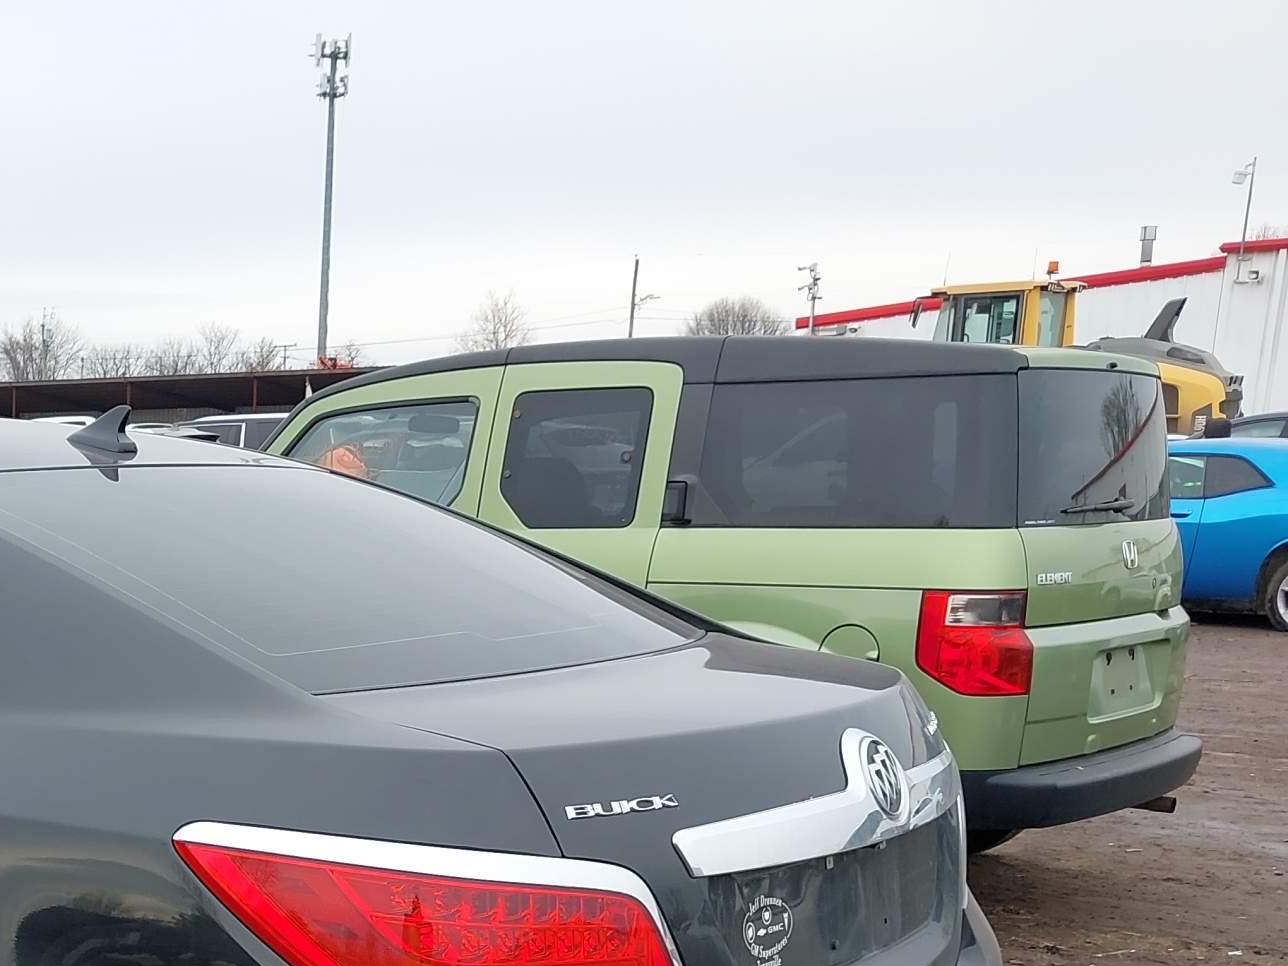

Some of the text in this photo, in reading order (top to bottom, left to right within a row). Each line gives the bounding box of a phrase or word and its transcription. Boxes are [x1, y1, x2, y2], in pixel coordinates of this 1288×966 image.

[1037, 572, 1072, 585] ELEMENT
[564, 793, 679, 820] BUICK
[768, 923, 784, 933] GMC
